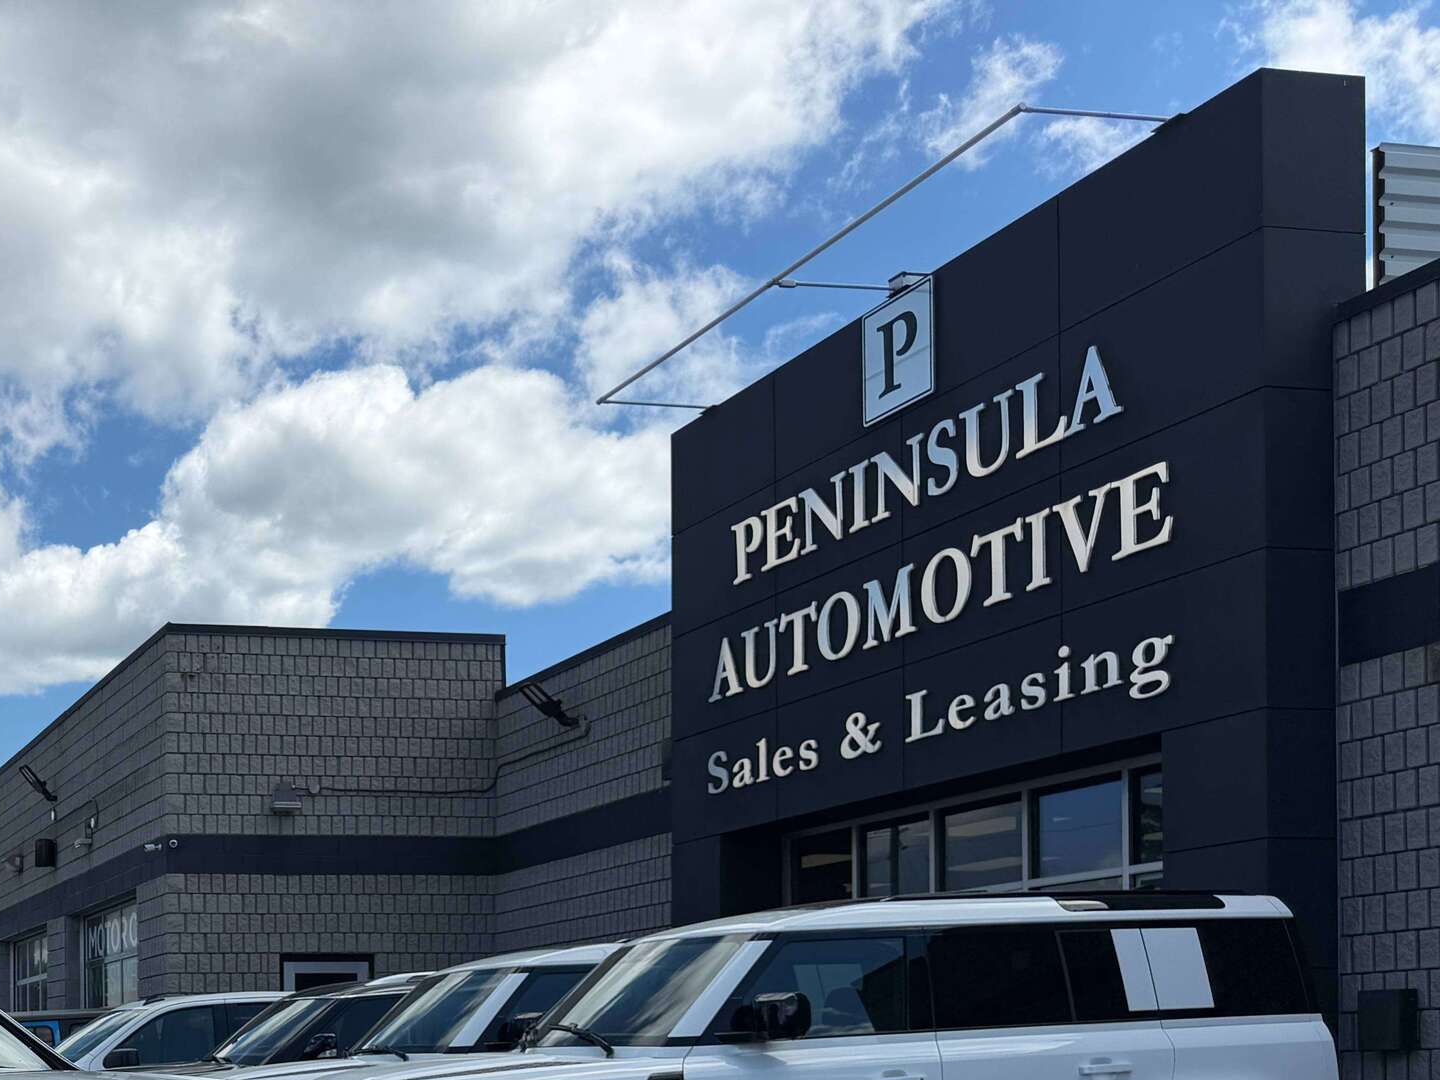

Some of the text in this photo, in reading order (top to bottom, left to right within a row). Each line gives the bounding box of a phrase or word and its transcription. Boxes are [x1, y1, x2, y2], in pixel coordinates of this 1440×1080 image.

[875, 309, 919, 400] P
[730, 345, 1124, 586] PENINSULA
[708, 461, 1175, 703] AUTOMOTIVE
[707, 634, 1176, 795] Sales & Leasing
